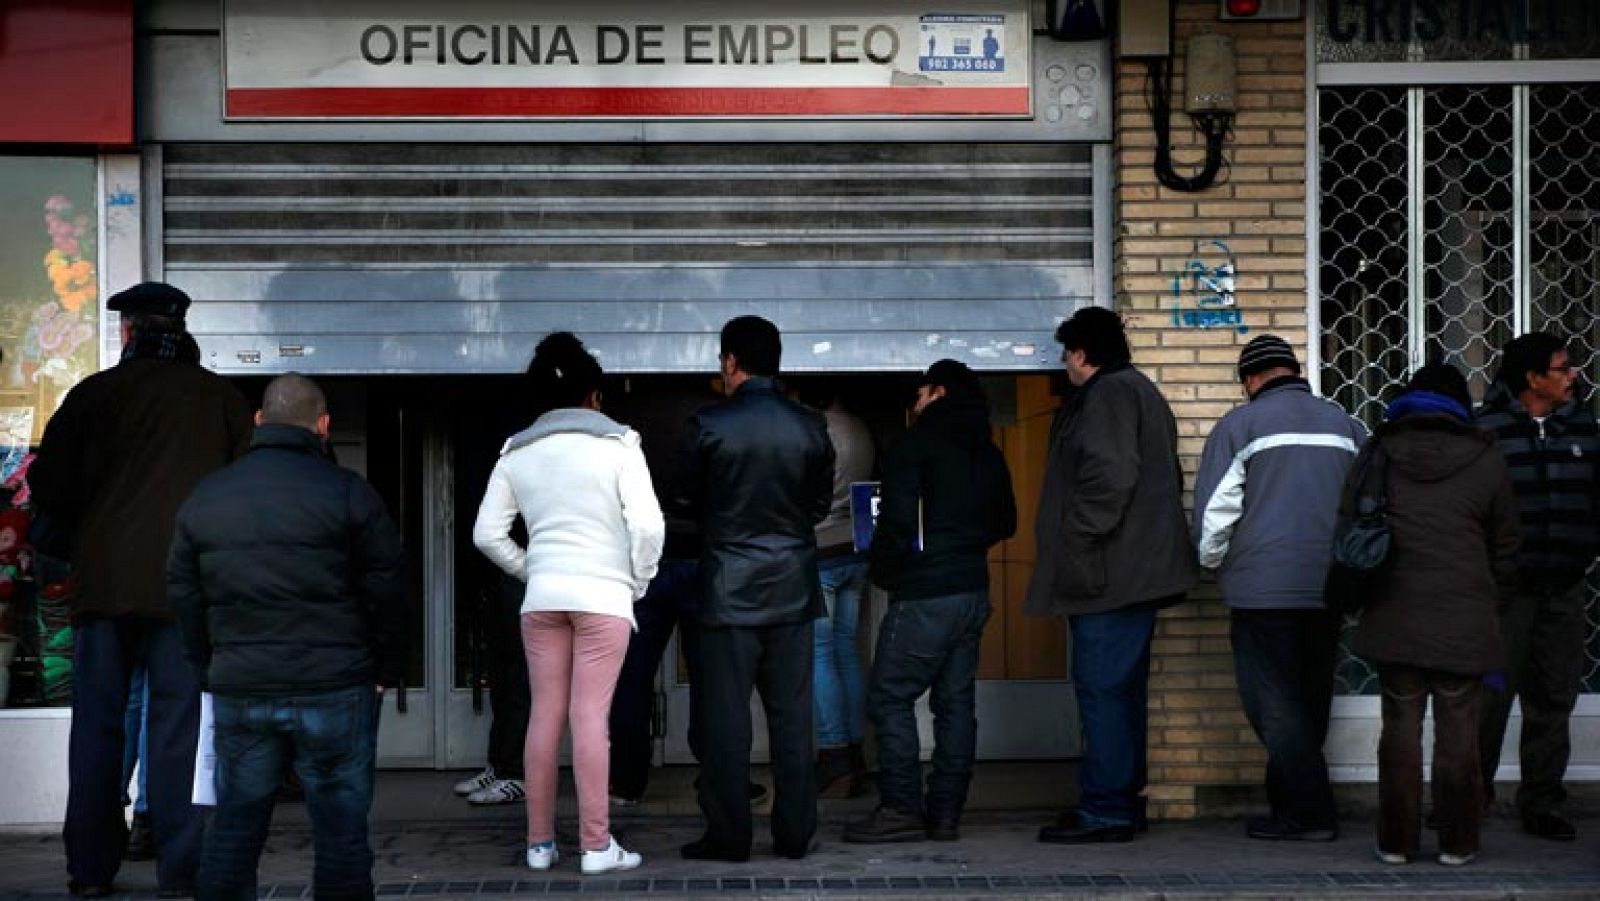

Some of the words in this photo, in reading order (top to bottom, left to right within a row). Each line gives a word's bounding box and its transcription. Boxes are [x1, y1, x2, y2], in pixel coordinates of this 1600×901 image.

[360, 24, 579, 65] OFICINA
[597, 24, 665, 64] DE
[683, 24, 899, 65] EMPLEO
